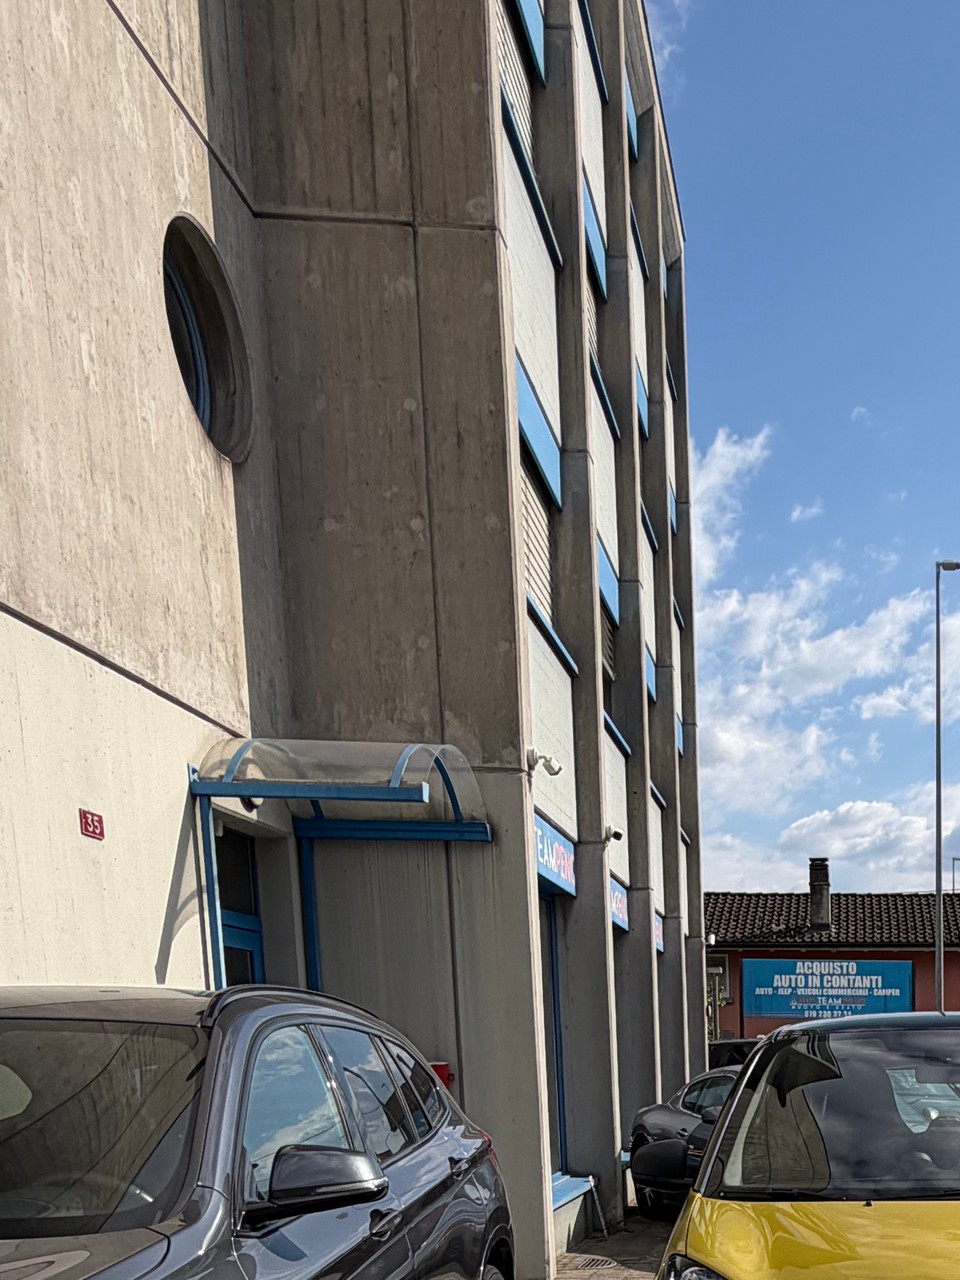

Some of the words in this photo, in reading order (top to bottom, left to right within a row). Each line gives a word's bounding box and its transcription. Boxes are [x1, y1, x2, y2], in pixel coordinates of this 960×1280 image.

[86, 813, 101, 834] 35
[796, 961, 857, 976] ACQUISTO
[773, 974, 806, 988] AUTO
[808, 975, 821, 988] IN
[823, 975, 882, 989] CONTANTI
[755, 987, 773, 995] AUTO
[796, 988, 822, 996] VEICOLI
[823, 988, 869, 996] COMMERCIALI
[873, 988, 900, 997] CAMPER
